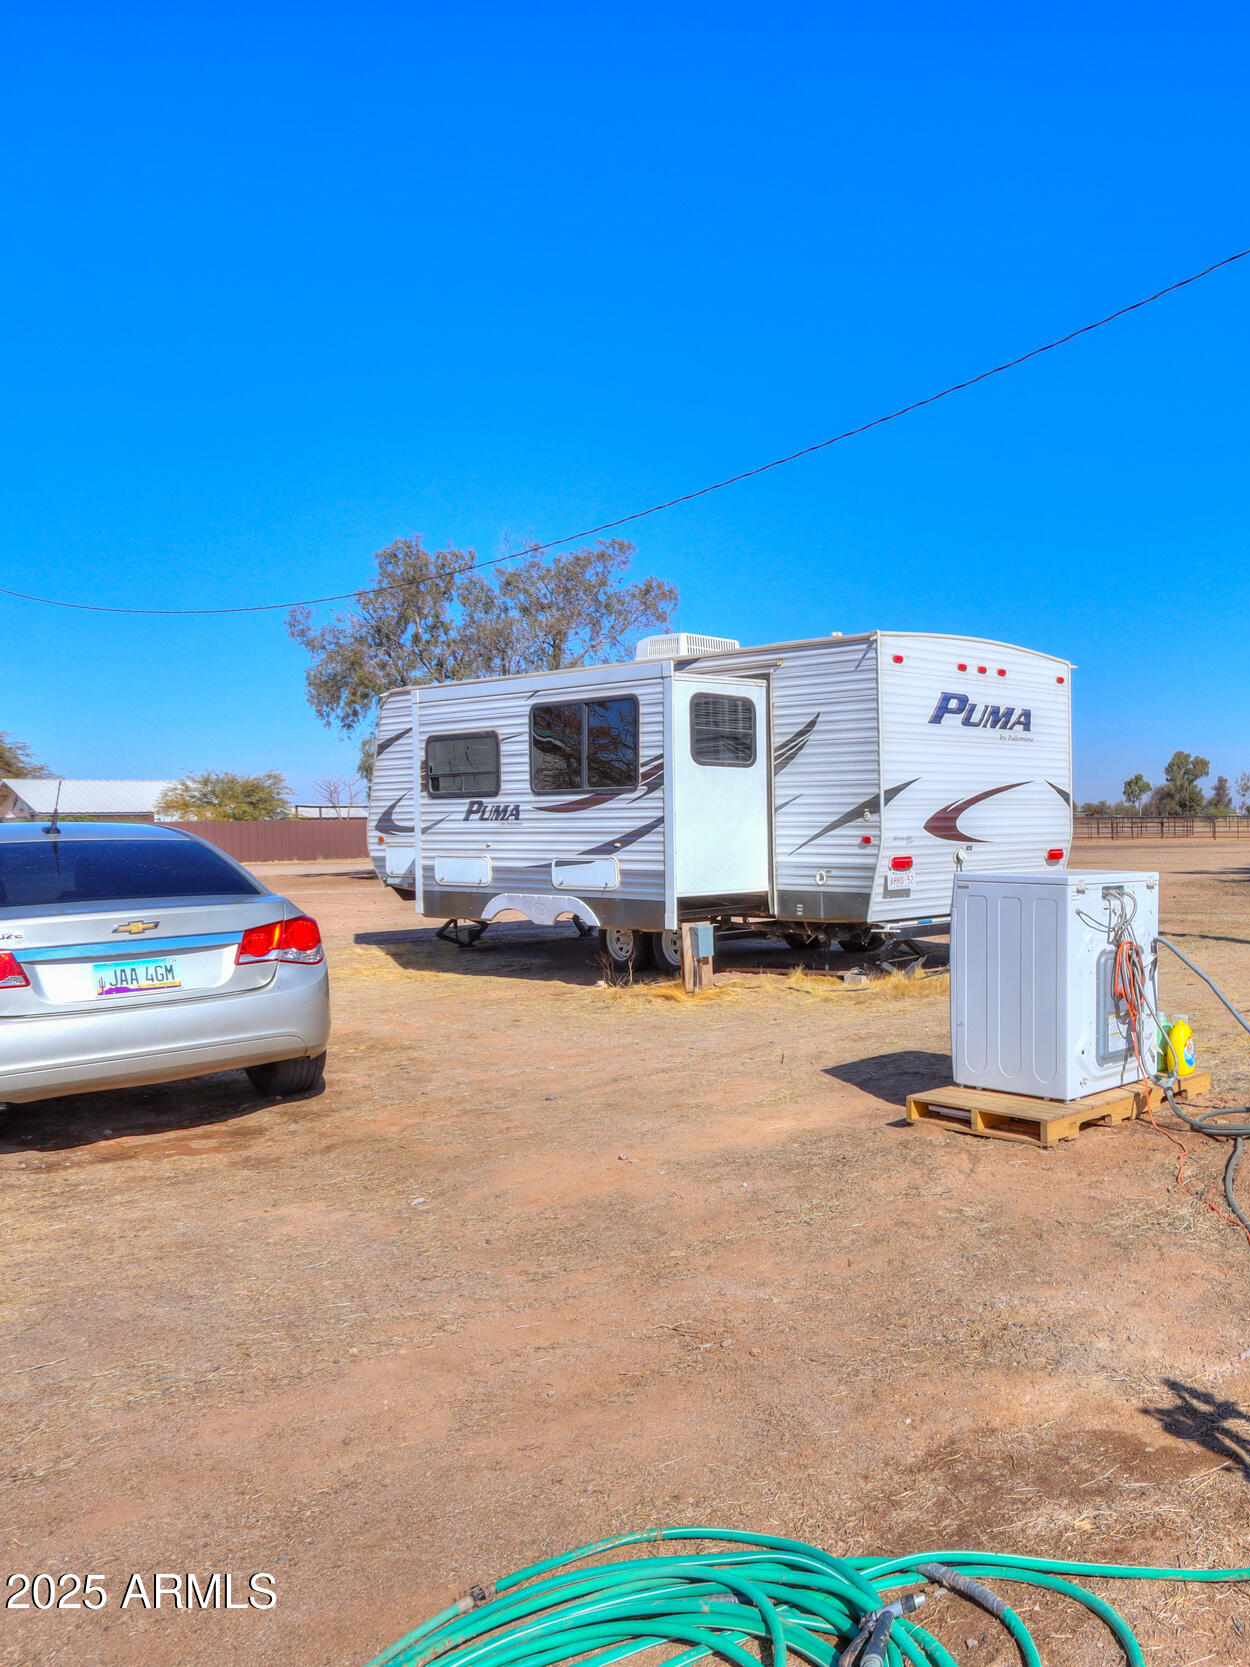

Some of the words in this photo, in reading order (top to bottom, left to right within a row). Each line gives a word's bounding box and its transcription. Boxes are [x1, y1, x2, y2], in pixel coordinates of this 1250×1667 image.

[928, 692, 1031, 732] PUMA
[463, 800, 521, 821] PUMA
[109, 967, 139, 986] JAA
[146, 964, 175, 983] 4GM
